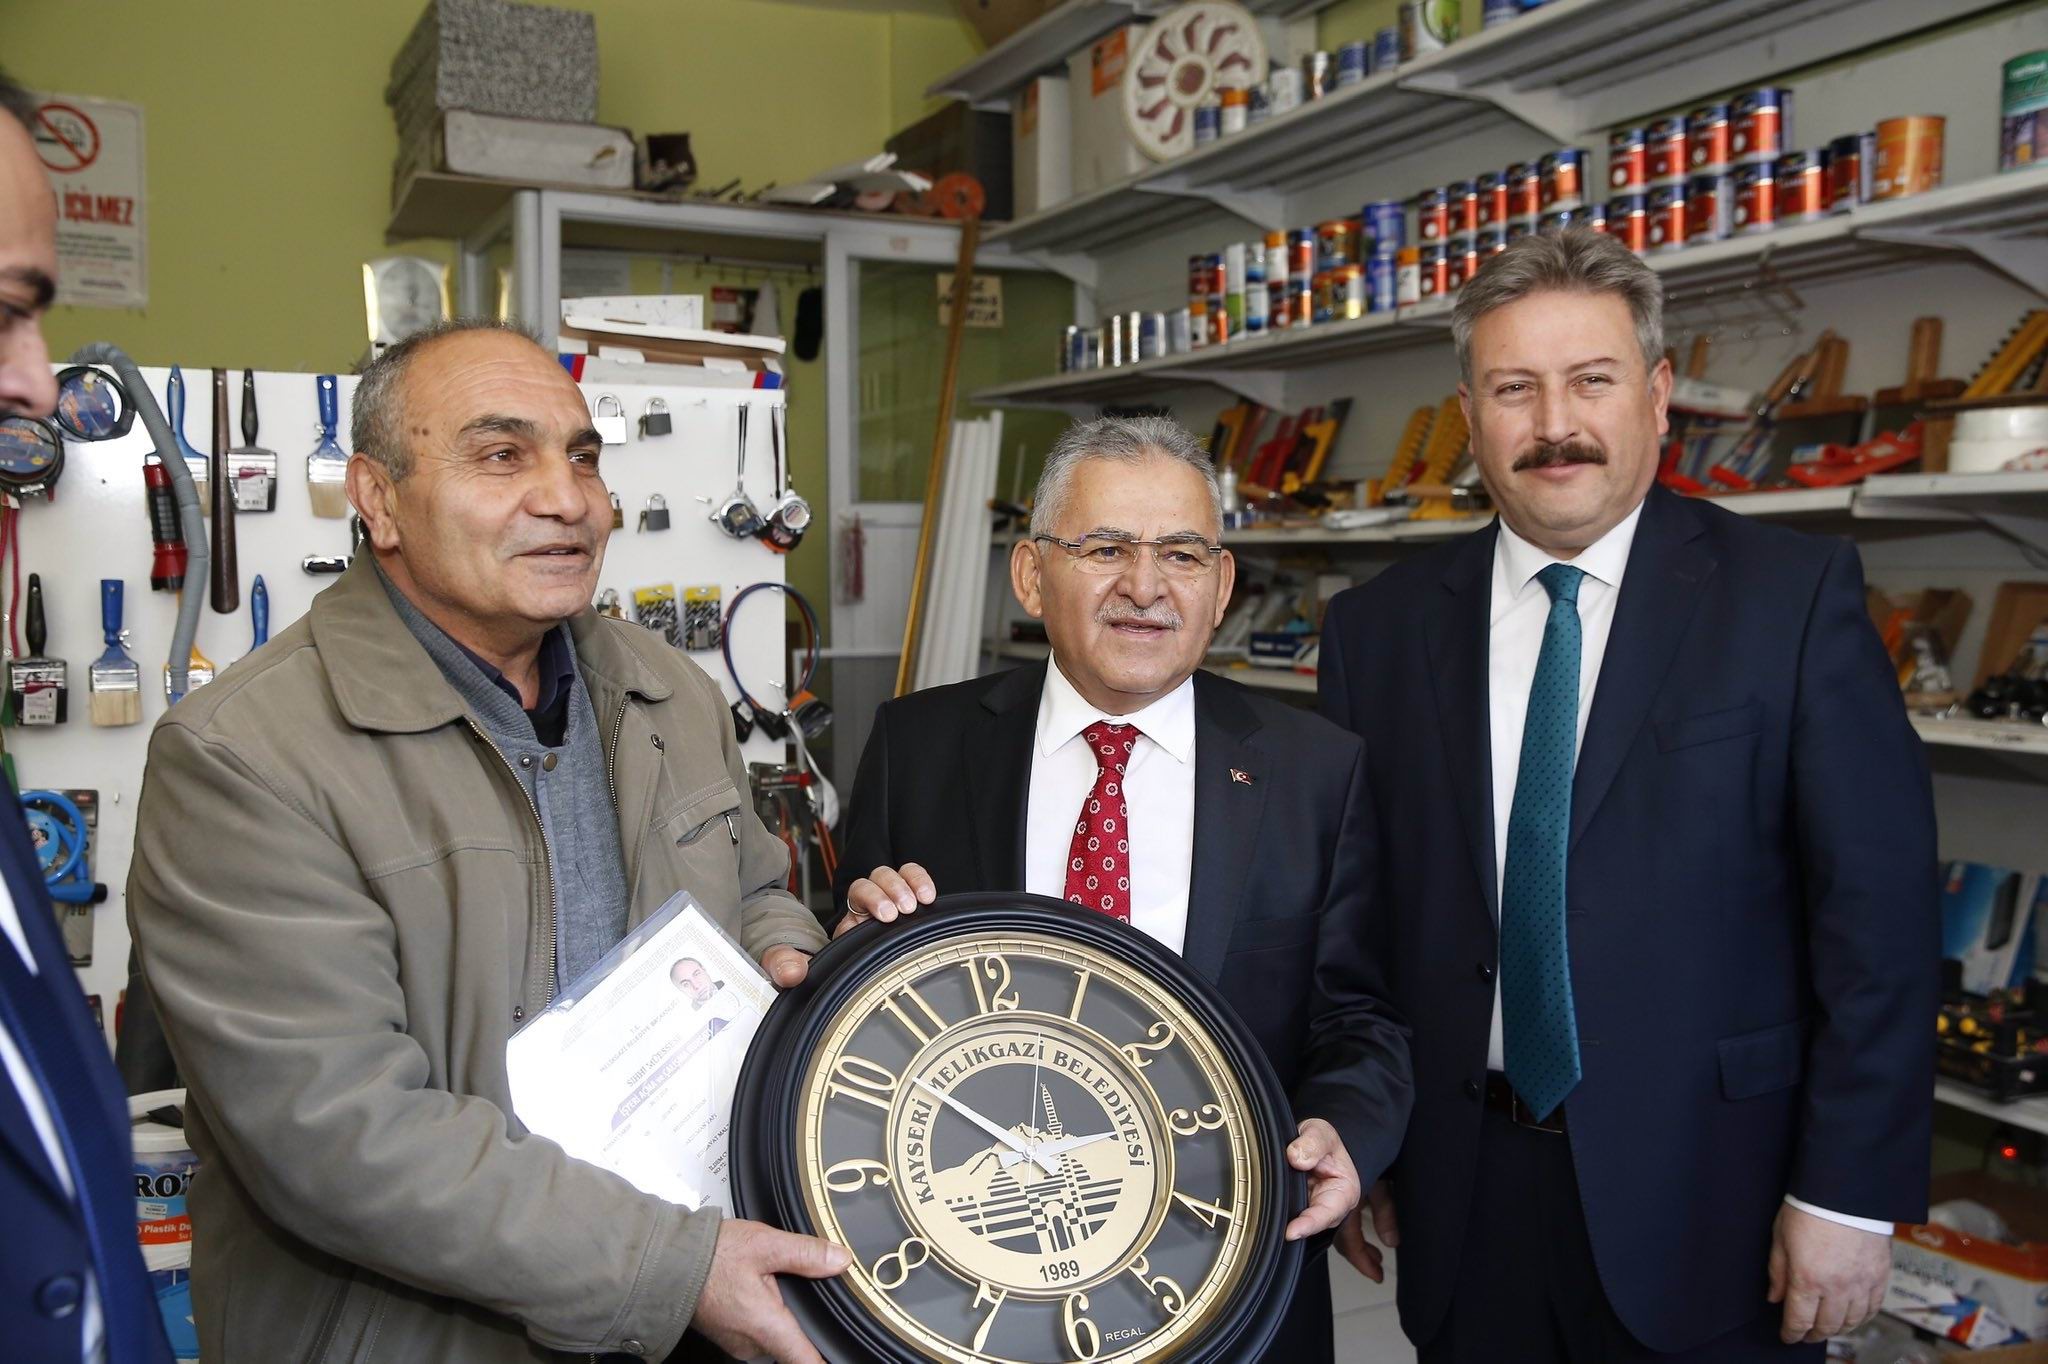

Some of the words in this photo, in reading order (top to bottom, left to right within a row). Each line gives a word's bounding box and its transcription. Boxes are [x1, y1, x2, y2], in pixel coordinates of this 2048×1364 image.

[961, 953, 1020, 1014] 12
[1069, 968, 1090, 1023] 1
[880, 983, 949, 1046] 11
[1120, 1021, 1176, 1067] 2
[828, 1055, 898, 1111] 10
[907, 1098, 935, 1205] KAYSERİ
[927, 1040, 1044, 1092] MELİKGAZİ
[1052, 1050, 1151, 1167] BELEDİYESİ
[1168, 1103, 1227, 1136] 3
[824, 1159, 892, 1192] 9
[144, 1224, 177, 1233] Plastik
[1173, 1188, 1232, 1229] 4
[873, 1236, 931, 1289] 8
[1040, 1260, 1080, 1283] 1989
[1127, 1253, 1186, 1317] 5
[972, 1281, 1008, 1353] 7
[1063, 1291, 1101, 1361] 6
[1105, 1326, 1146, 1343] REGAL
